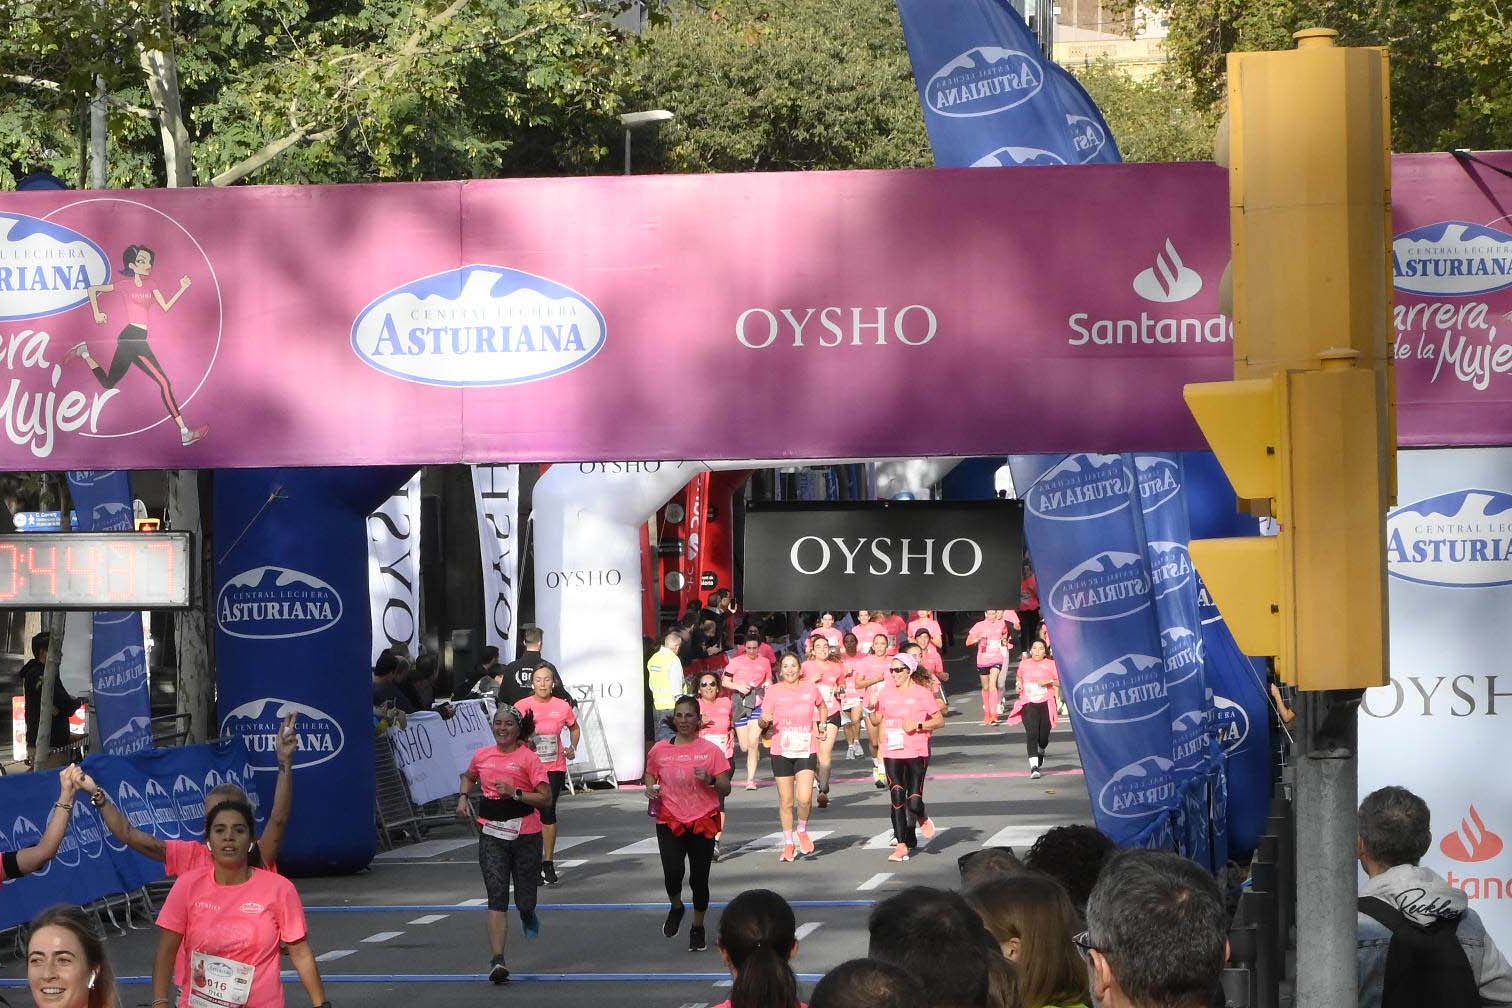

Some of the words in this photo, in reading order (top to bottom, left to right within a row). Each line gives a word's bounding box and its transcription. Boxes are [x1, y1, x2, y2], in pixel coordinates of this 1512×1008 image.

[13, 248, 86, 260] LECHERA
[735, 304, 938, 349] OYSHO
[1394, 302, 1489, 330] arrera
[371, 312, 586, 356] ASTURIANA
[1417, 333, 1435, 359] la
[1414, 524, 1482, 535] CENTRAL
[790, 535, 983, 577] OYSHO
[546, 569, 622, 589] OYSHO
[233, 590, 276, 599] CENTRAL
[221, 596, 333, 623] ASTURIANA
[207, 979, 227, 991] 016
